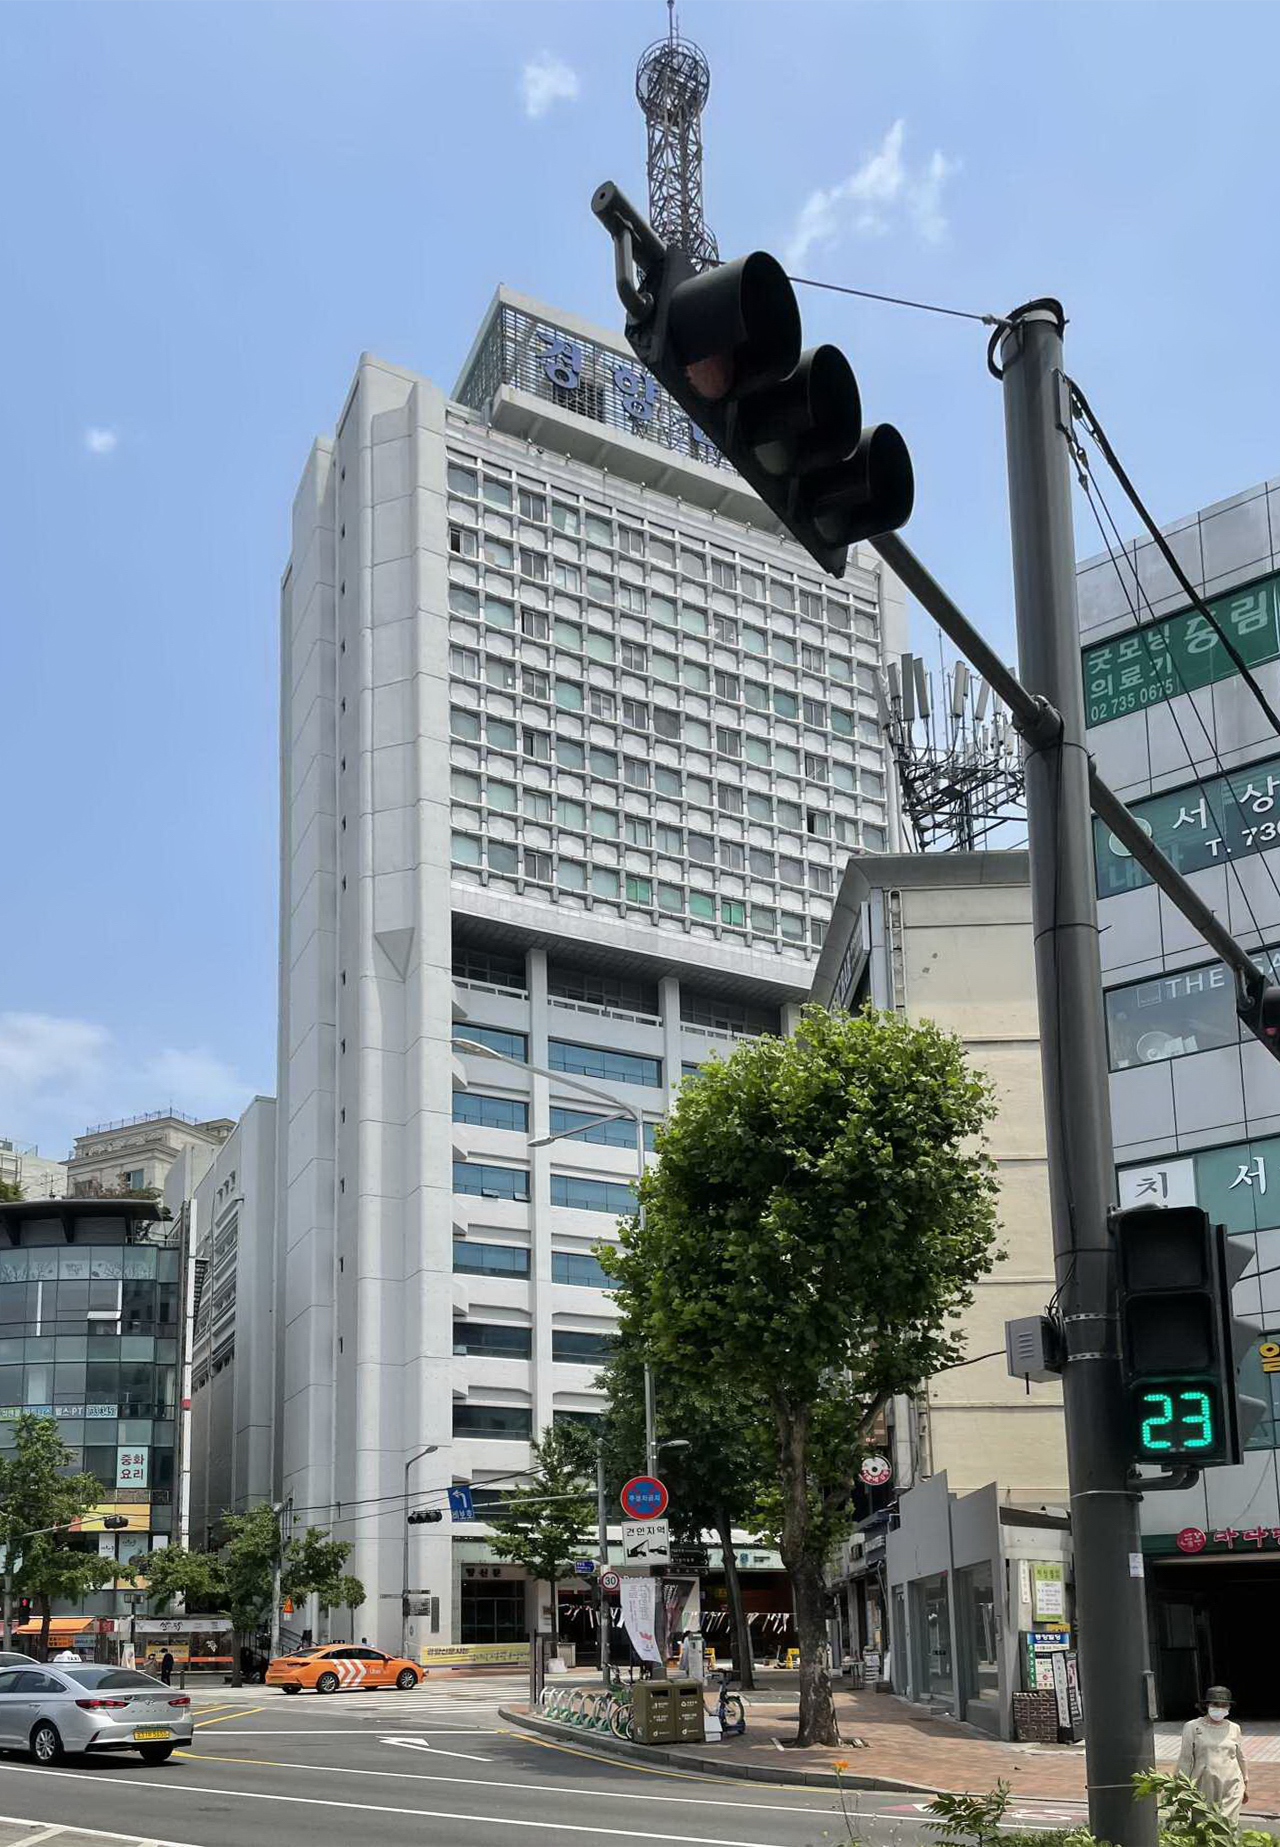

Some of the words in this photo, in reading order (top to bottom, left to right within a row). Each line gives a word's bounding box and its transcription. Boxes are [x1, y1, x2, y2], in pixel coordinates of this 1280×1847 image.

[1091, 653, 1172, 698] 의료기
[1091, 703, 1107, 721] 02
[1111, 693, 1135, 714] 735
[1140, 678, 1174, 703] 0675
[1241, 822, 1280, 846] 73
[1165, 968, 1225, 999] THE
[1142, 1391, 1213, 1449] 23
[121, 1454, 144, 1466] 중화
[120, 1468, 143, 1480] 요리
[626, 1526, 665, 1537] 견인지역
[604, 1576, 616, 1586] 30
